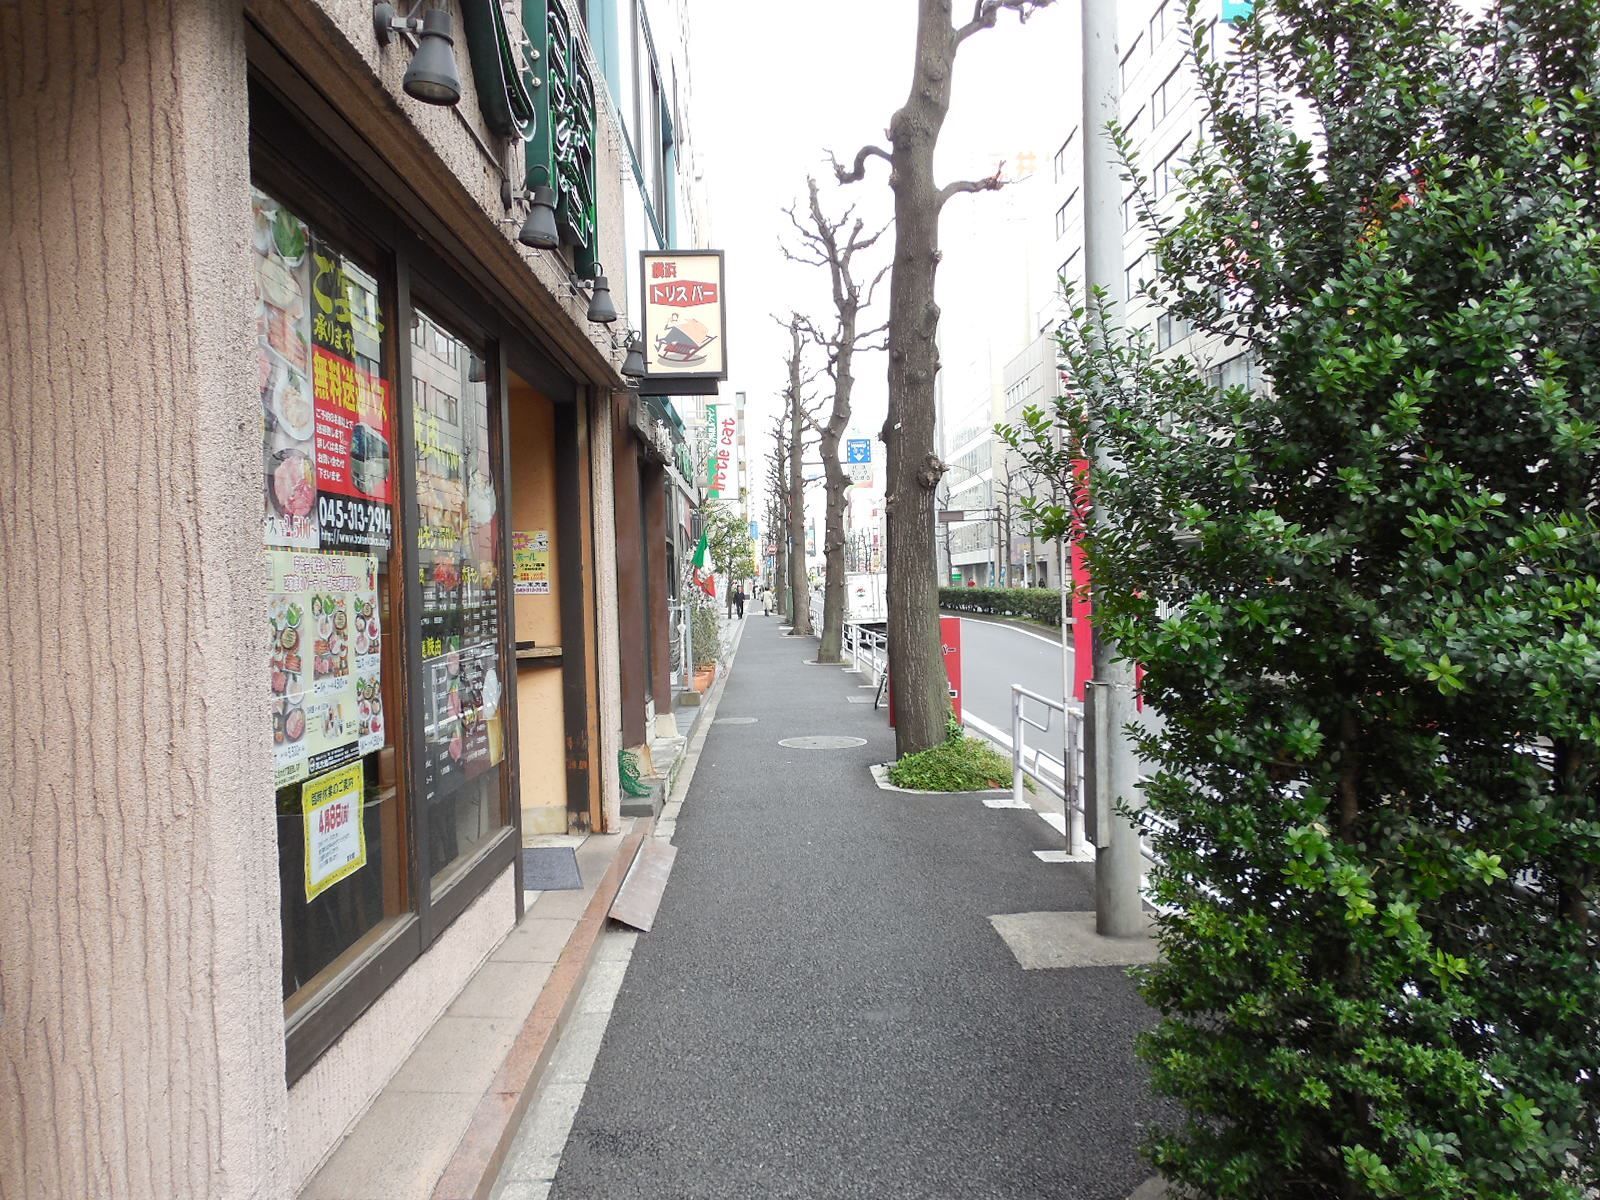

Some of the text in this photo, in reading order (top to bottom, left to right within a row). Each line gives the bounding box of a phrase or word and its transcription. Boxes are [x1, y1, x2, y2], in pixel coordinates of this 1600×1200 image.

[652, 262, 677, 278] 横浜
[313, 352, 388, 422] 無料送迎バス
[721, 417, 736, 446] cat
[319, 496, 392, 534] 045-313-2914
